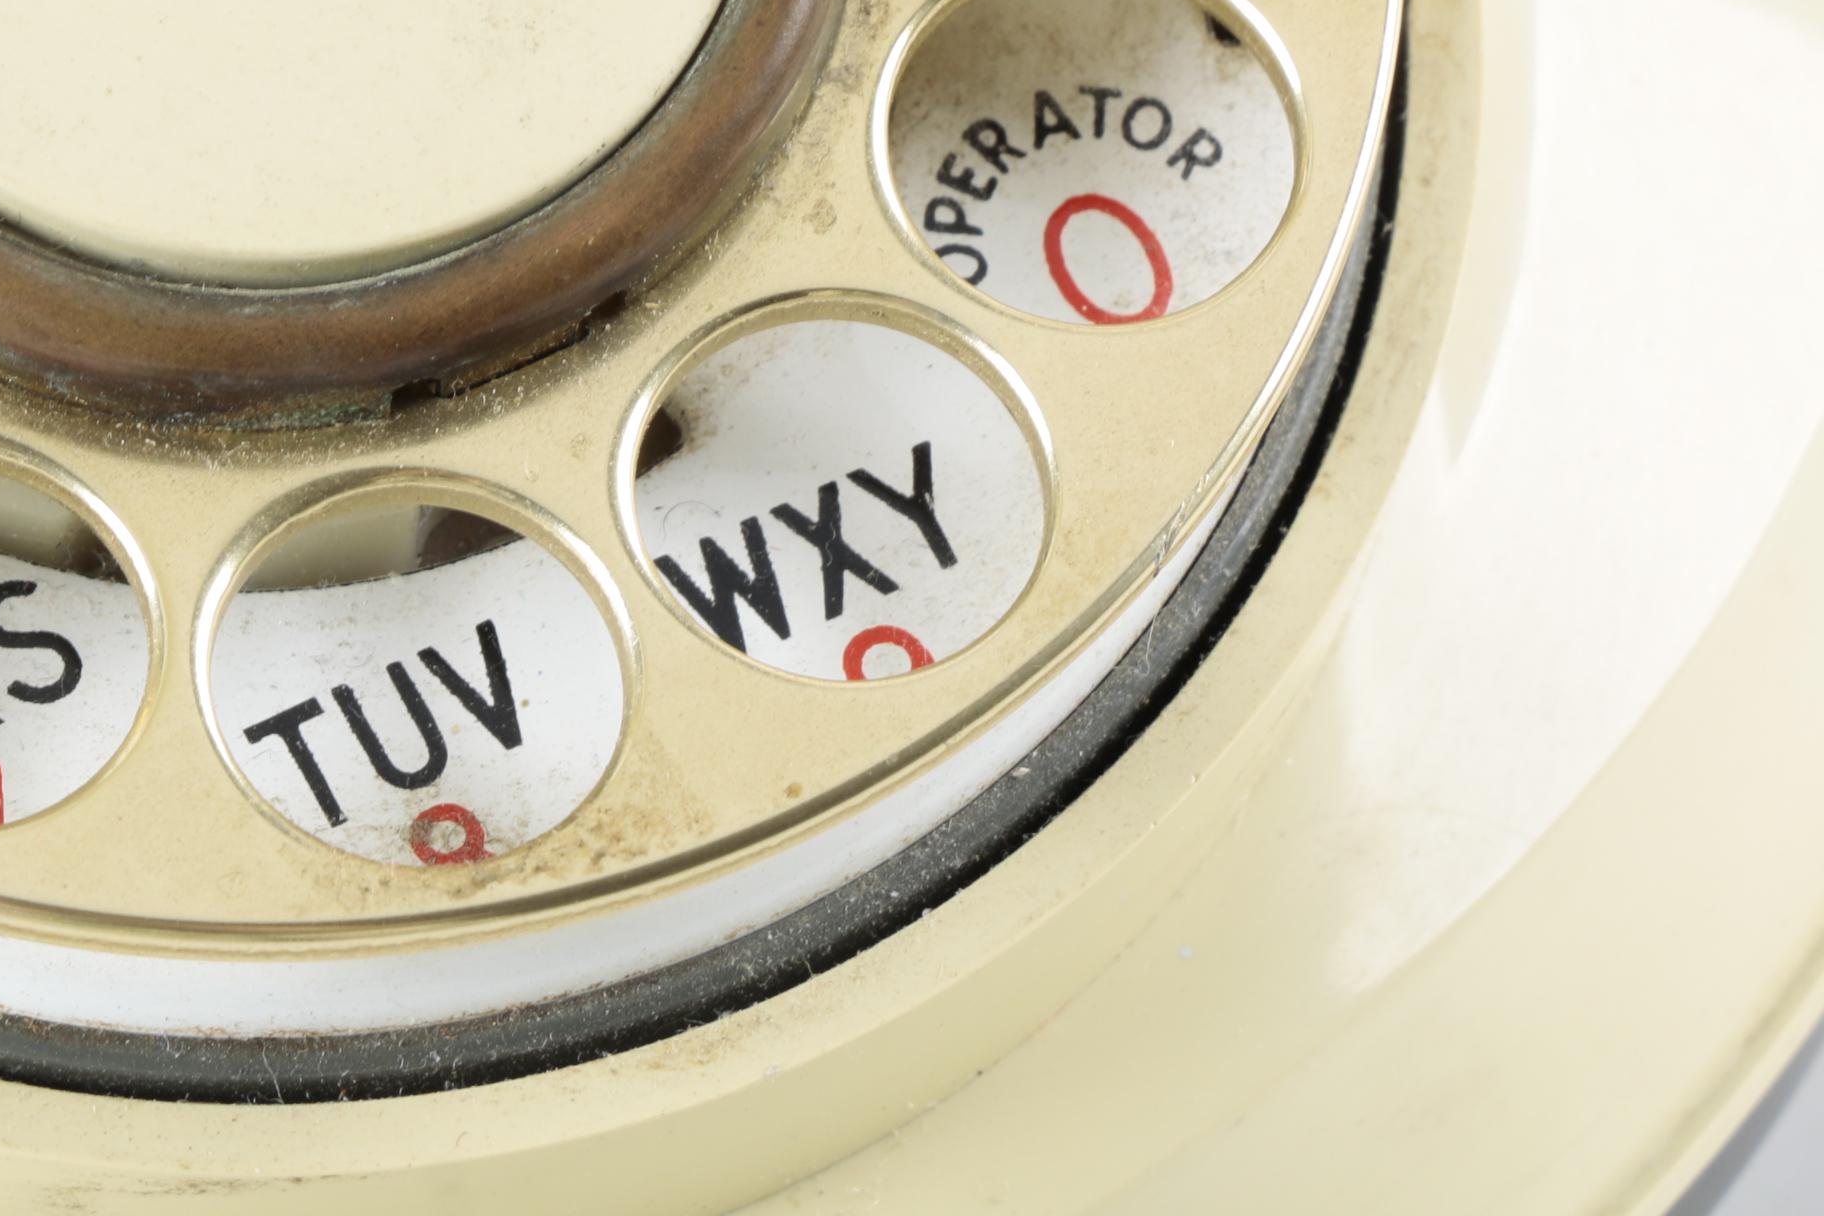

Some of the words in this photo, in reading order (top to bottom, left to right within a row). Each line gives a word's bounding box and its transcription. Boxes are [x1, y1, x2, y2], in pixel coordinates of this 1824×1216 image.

[923, 84, 1225, 286] OPERATOR
[653, 440, 958, 654] WXY
[244, 618, 523, 829] TUV
